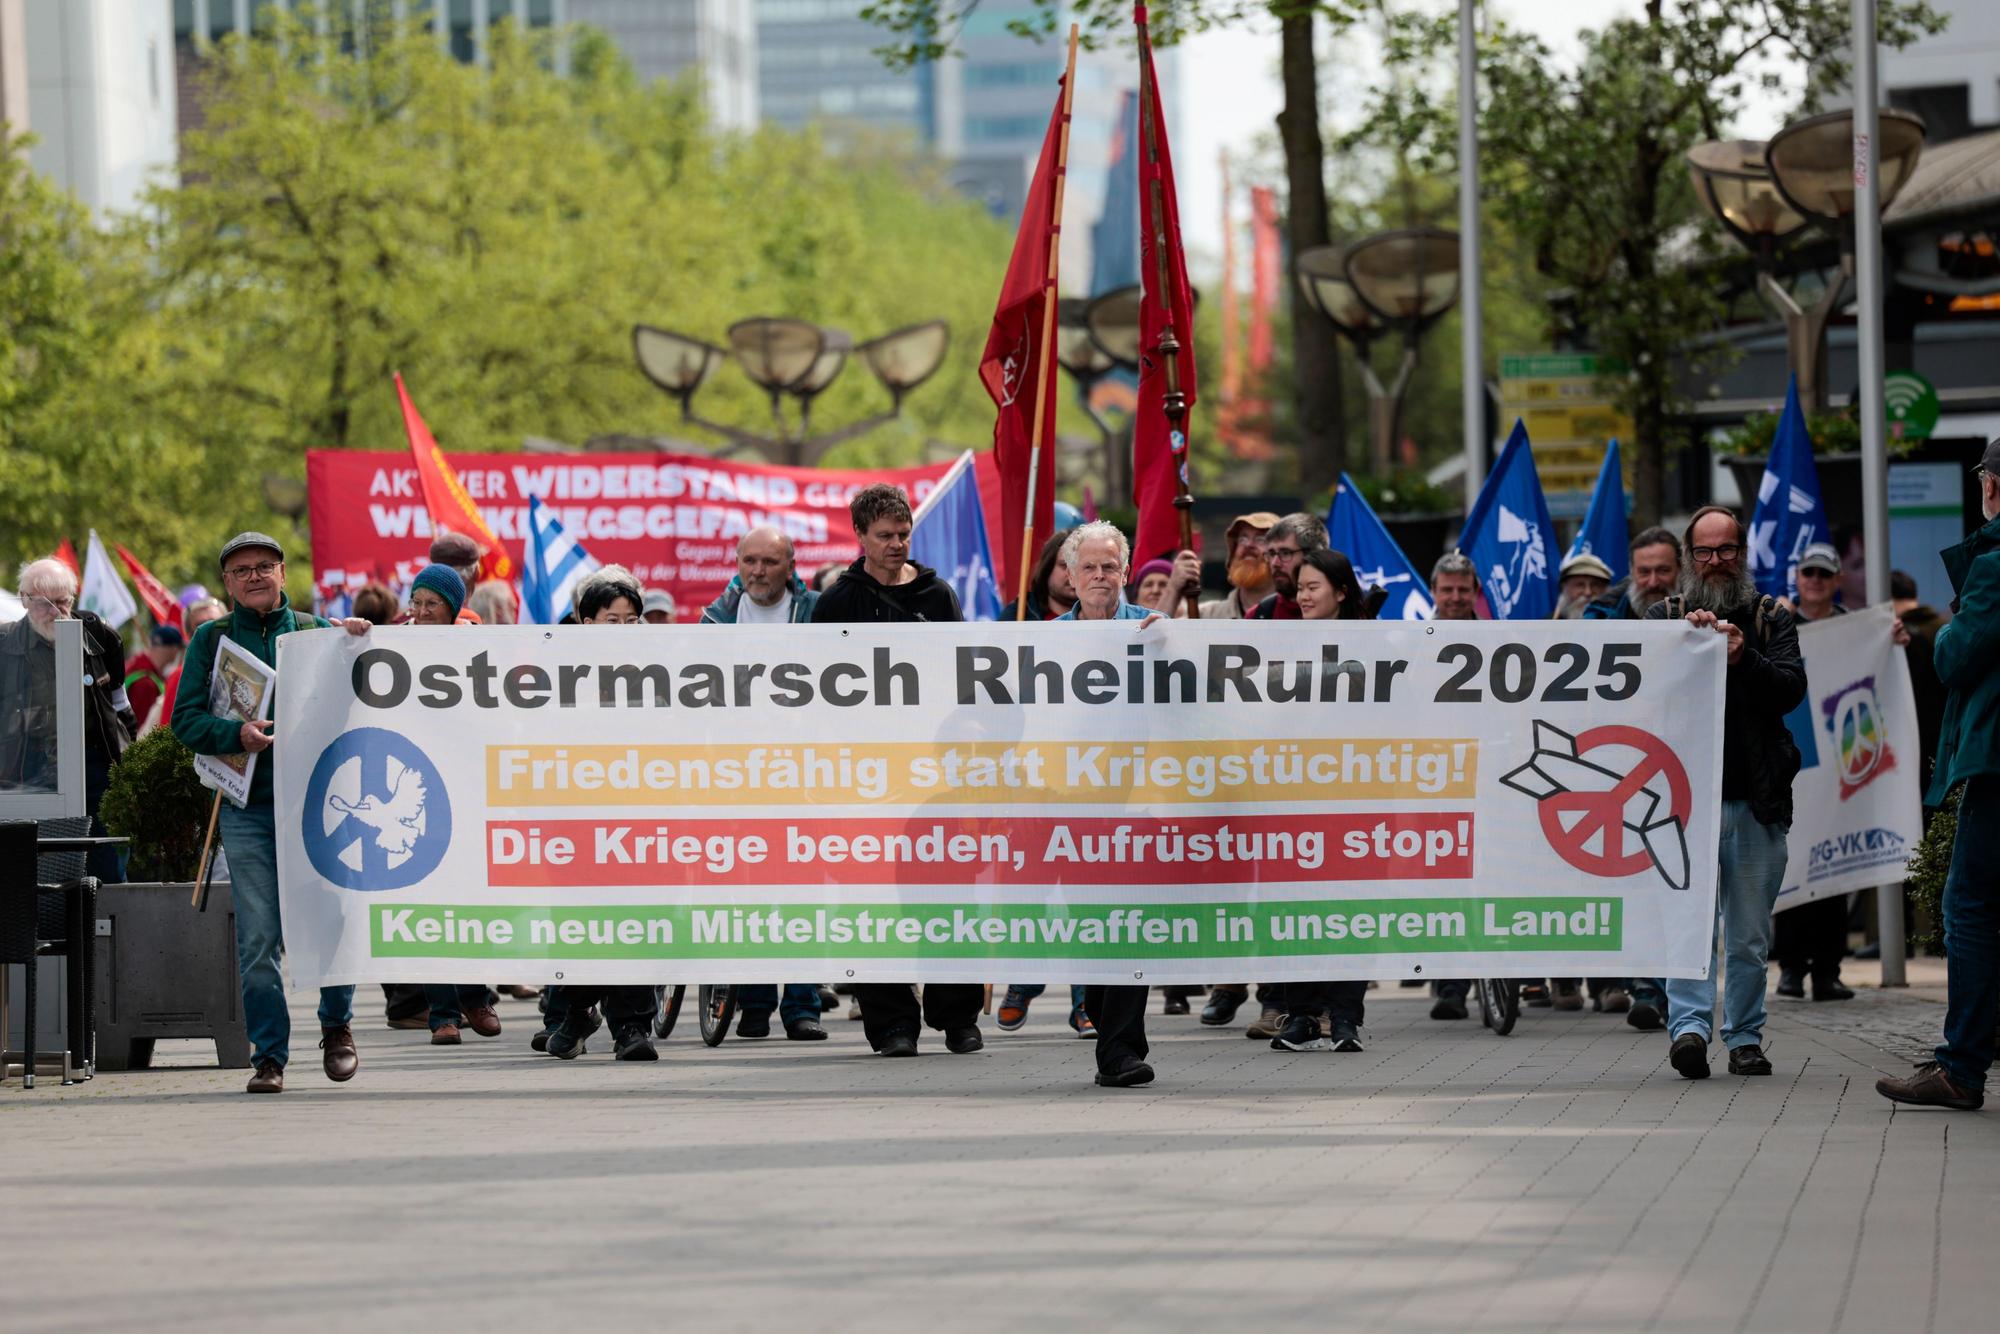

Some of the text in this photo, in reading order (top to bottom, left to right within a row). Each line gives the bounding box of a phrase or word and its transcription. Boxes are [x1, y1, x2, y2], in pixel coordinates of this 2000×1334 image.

[512, 464, 800, 507] WIDERSTAND
[351, 642, 1643, 709] Ostermarsch RheinRuhr 2025
[498, 744, 1467, 798] Friedensfähig statt Kriegstüchtig!
[491, 820, 1470, 873] Die Kriege beenden, Aufrüstung stop!
[381, 902, 1611, 945] Keine neuen Mittelstreckenwaffen in unserem Land!
